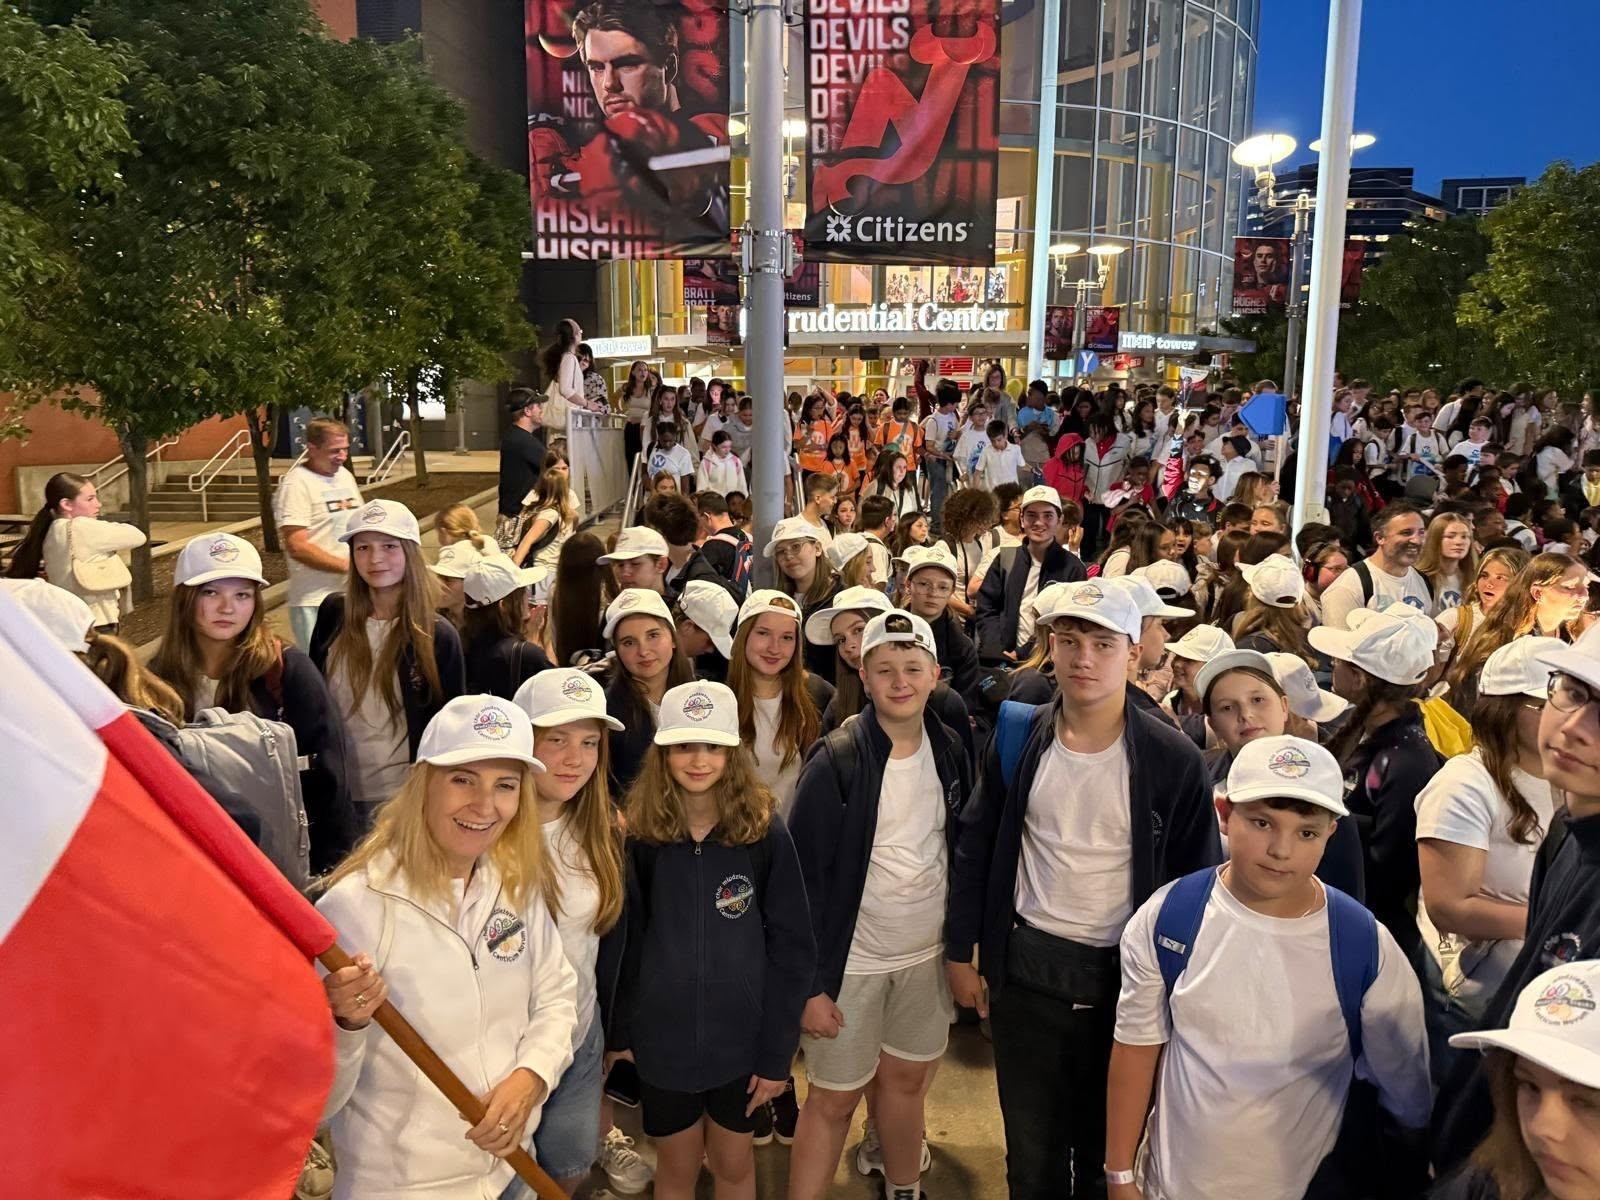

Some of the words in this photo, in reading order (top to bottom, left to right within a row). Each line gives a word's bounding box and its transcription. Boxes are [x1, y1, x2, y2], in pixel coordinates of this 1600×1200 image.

[811, 17, 910, 50] DEVILS
[856, 216, 968, 242] Citizens
[784, 293, 811, 301] tizens
[783, 302, 913, 333] rudential
[918, 302, 1010, 333] Center
[1156, 336, 1197, 350] tower
[1081, 351, 1095, 372] Y
